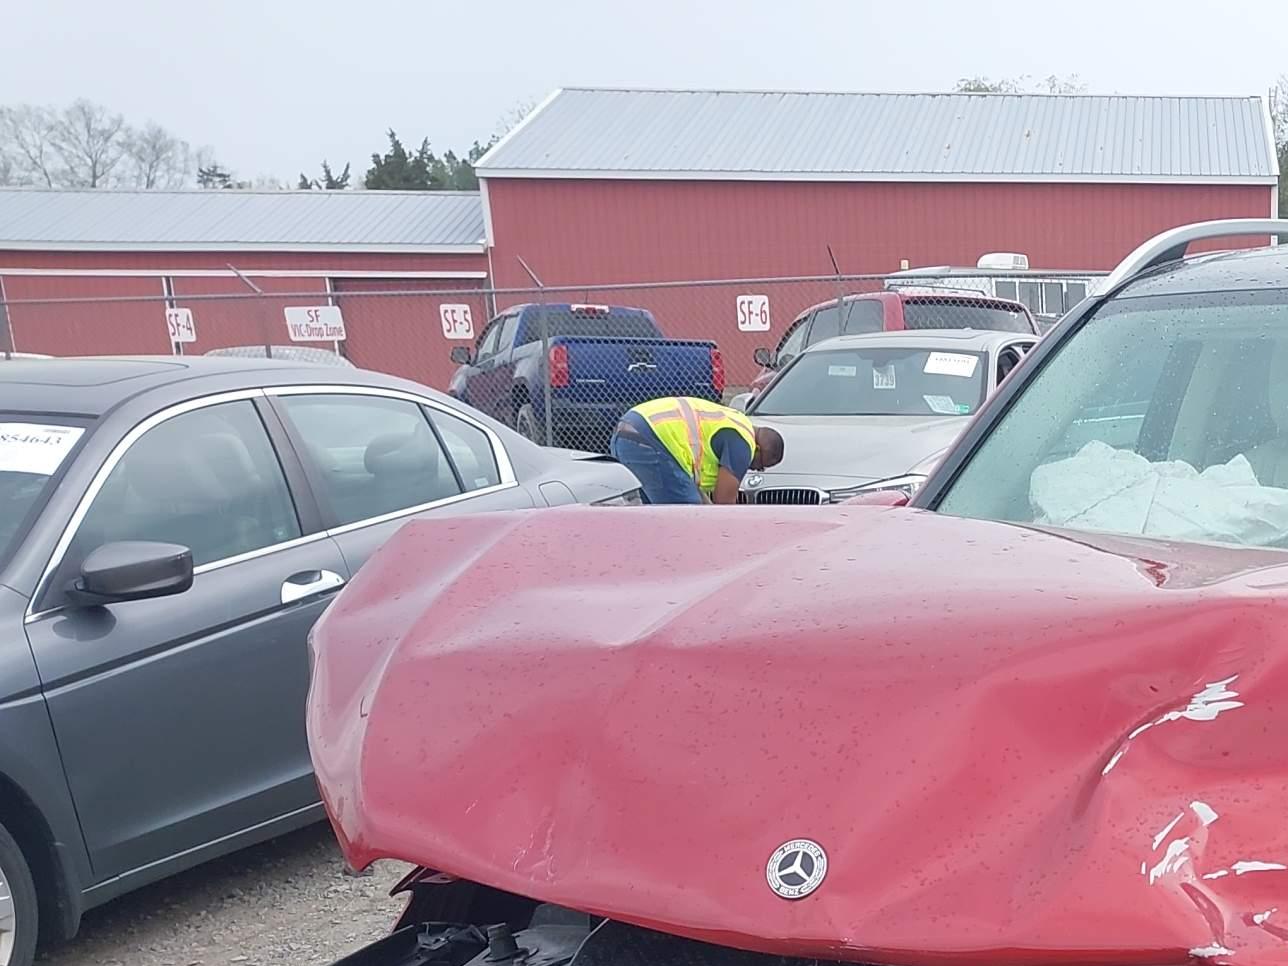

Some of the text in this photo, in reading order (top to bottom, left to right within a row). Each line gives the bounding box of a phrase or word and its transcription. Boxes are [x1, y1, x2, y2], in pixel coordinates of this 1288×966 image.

[306, 309, 321, 323] SF
[443, 309, 471, 333] SF-5
[739, 300, 768, 325] SF-6
[168, 313, 194, 337] SF-4
[323, 322, 344, 337] Zone
